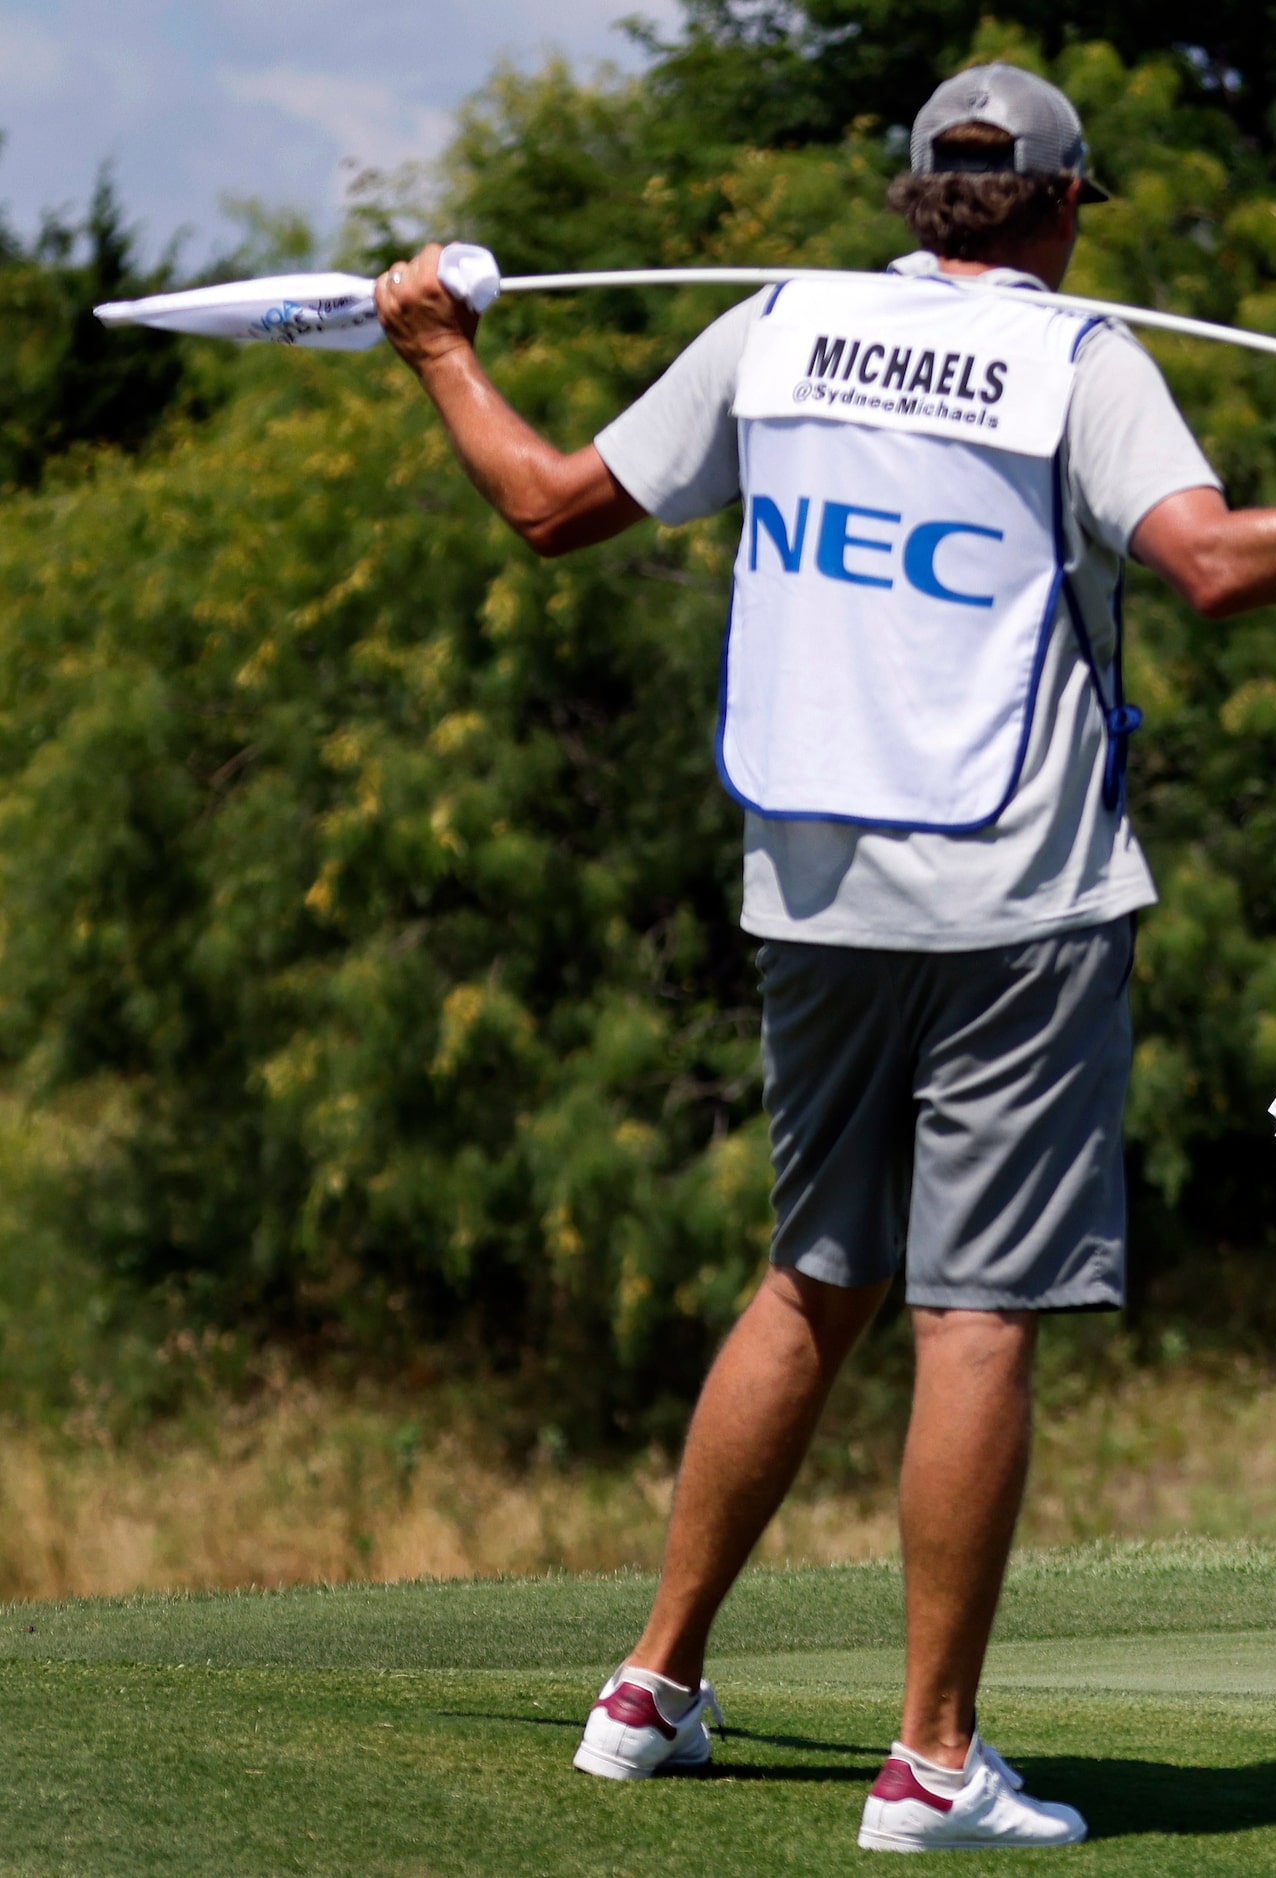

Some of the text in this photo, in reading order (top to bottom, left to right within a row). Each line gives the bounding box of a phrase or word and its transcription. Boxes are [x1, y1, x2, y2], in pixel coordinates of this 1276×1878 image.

[806, 333, 1009, 404] MICHAELS
[792, 381, 999, 429] @SydneeMichaels
[748, 494, 1004, 608] NEC
